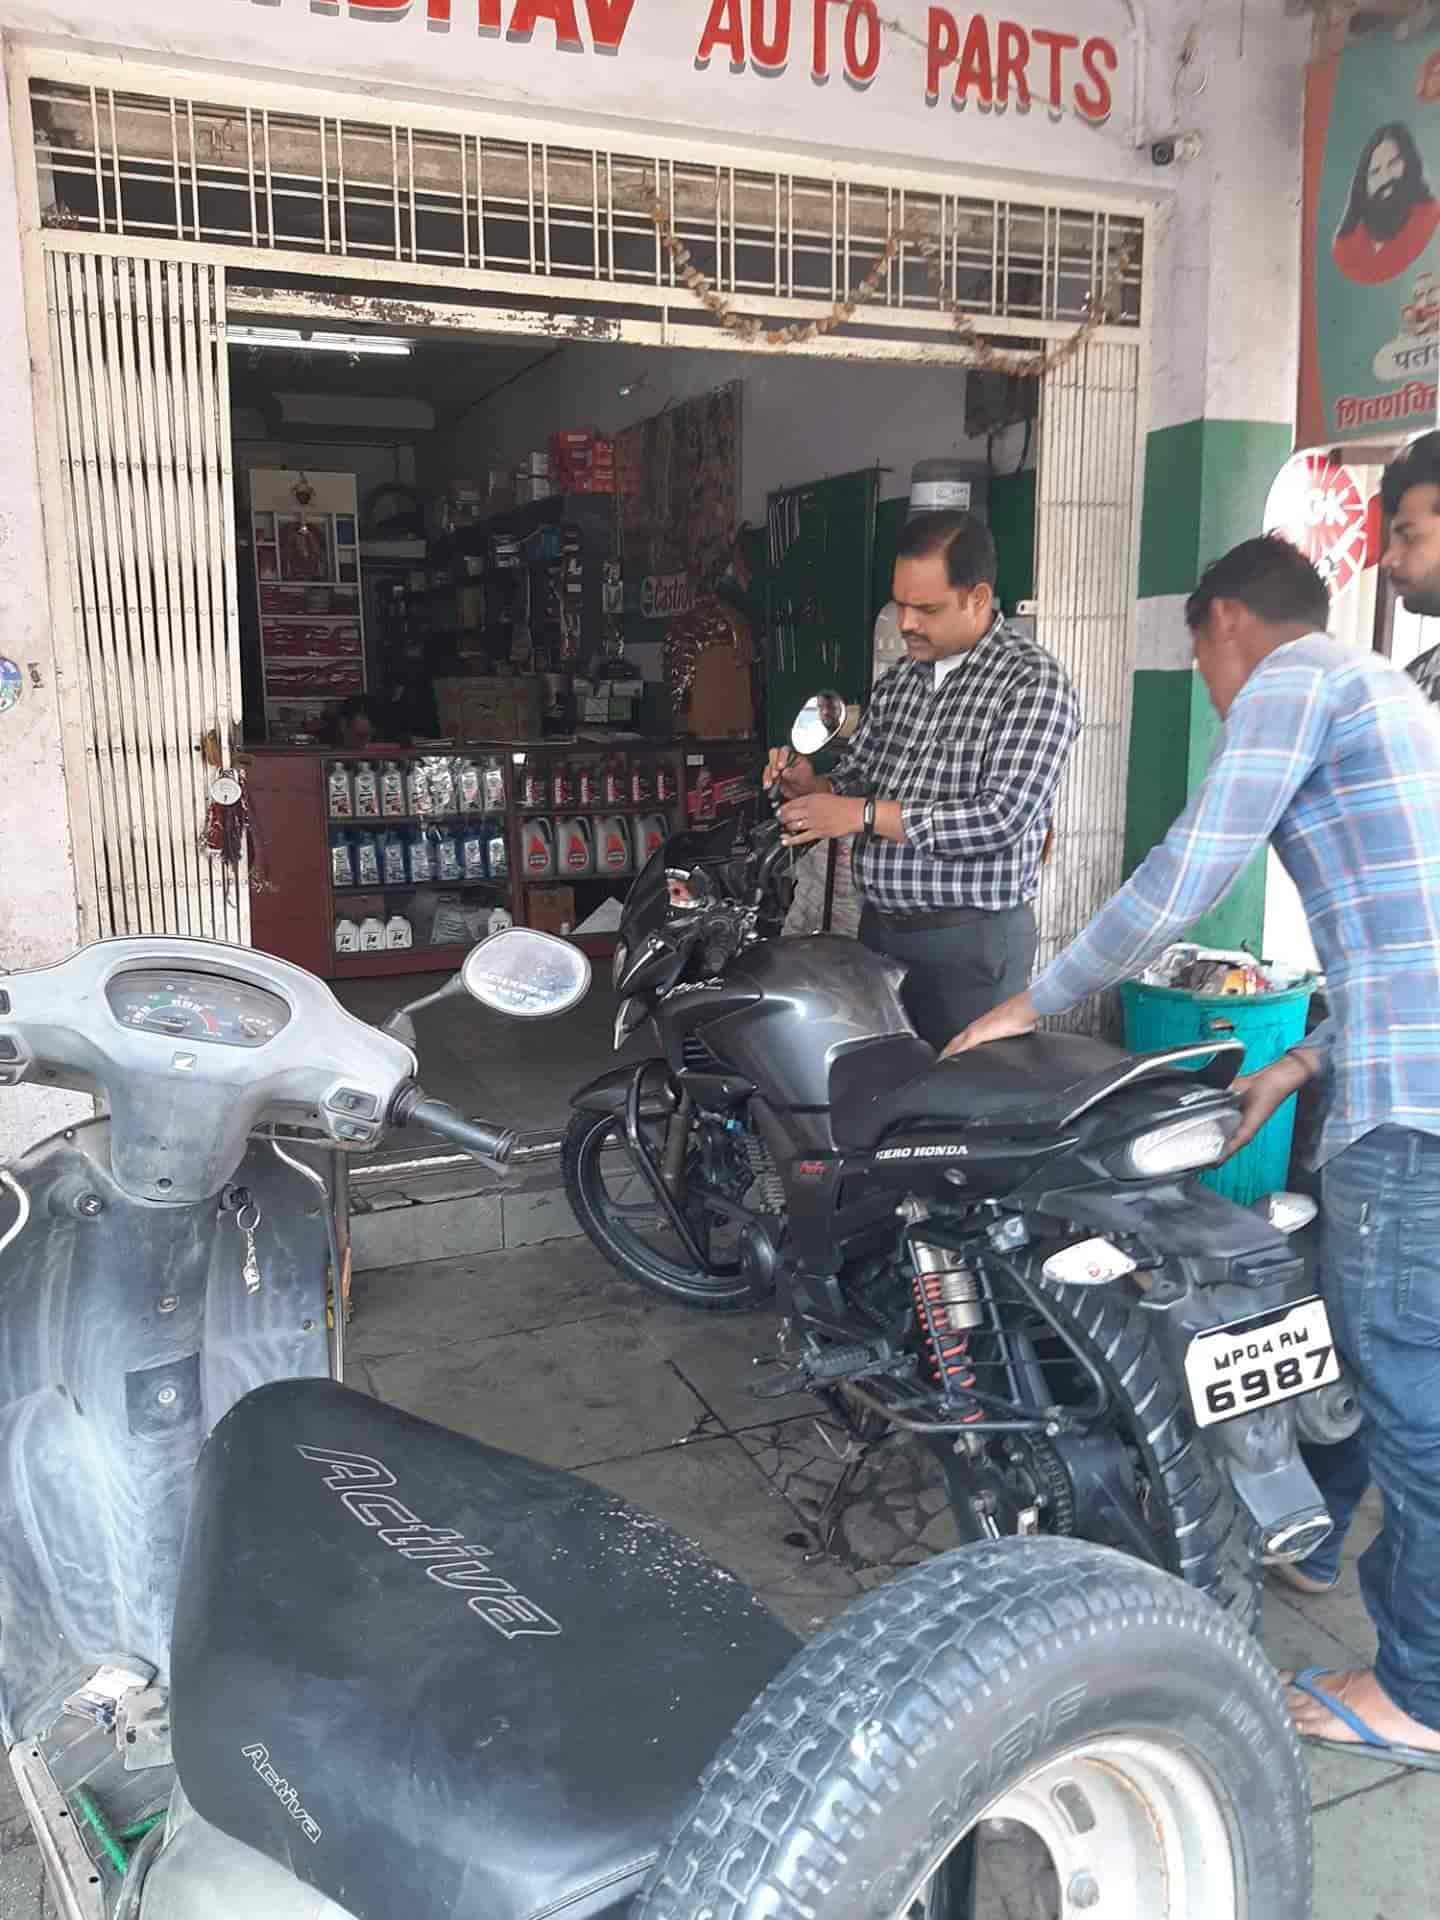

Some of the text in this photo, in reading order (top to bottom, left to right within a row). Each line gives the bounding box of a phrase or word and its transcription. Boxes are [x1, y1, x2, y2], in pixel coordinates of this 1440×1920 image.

[695, 0, 881, 86] AUTO
[926, 6, 1119, 122] PARTS
[913, 1145, 969, 1158] HONDA
[1205, 1344, 1333, 1414] 6987
[1213, 1339, 1274, 1371] MP04
[294, 1443, 563, 1640] Activa
[241, 1742, 323, 1844] Activa
